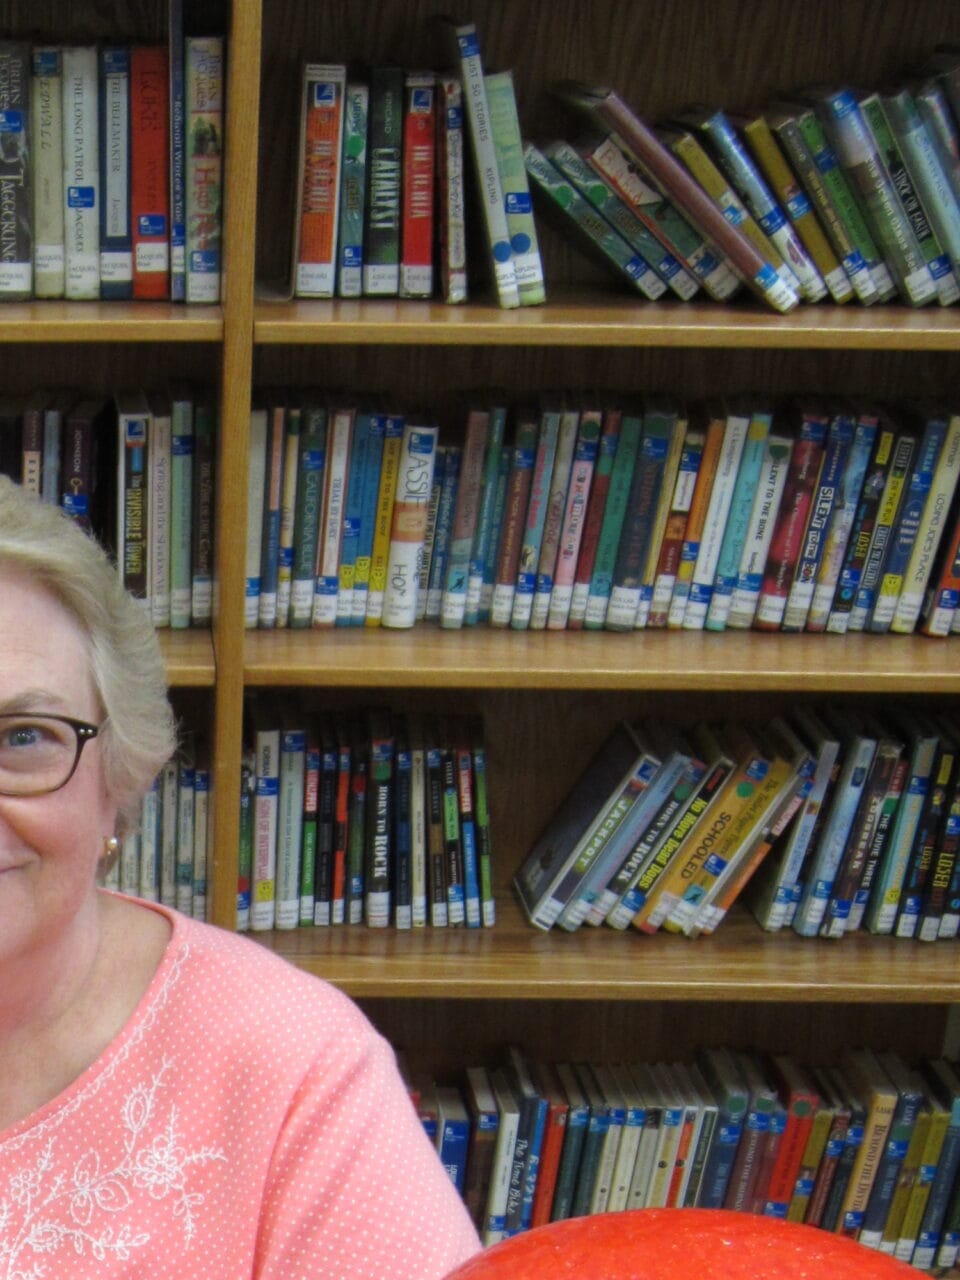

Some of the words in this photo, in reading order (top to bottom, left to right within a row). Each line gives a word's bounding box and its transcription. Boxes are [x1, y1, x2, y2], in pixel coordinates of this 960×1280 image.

[73, 76, 83, 100] THE
[73, 102, 83, 137] LONG
[472, 84, 480, 100] SO
[476, 101, 489, 141] STORIES
[111, 99, 121, 173] BELLMAKER
[74, 138, 85, 184] PATROL
[371, 147, 399, 229] CATALYST
[486, 167, 498, 204] KIPLING
[405, 454, 430, 508] ASSIE
[303, 471, 321, 544] CALIFORNIA
[811, 486, 834, 529] SILENT
[931, 493, 947, 527] LOSING
[125, 541, 141, 575] TOWER
[378, 785, 388, 815] BORN
[690, 798, 709, 814] No
[578, 798, 628, 868] JACKPOT
[673, 812, 698, 841] More
[372, 833, 388, 879] ROCK
[679, 811, 732, 880] SCHOOLED
[875, 833, 885, 857] JUVIE
[639, 860, 662, 889] Dogs
[861, 860, 876, 888] THREE
[933, 852, 955, 888] LOSER
[516, 1139, 529, 1158] The
[514, 1160, 526, 1186] Time
[507, 1189, 521, 1215] Bike
